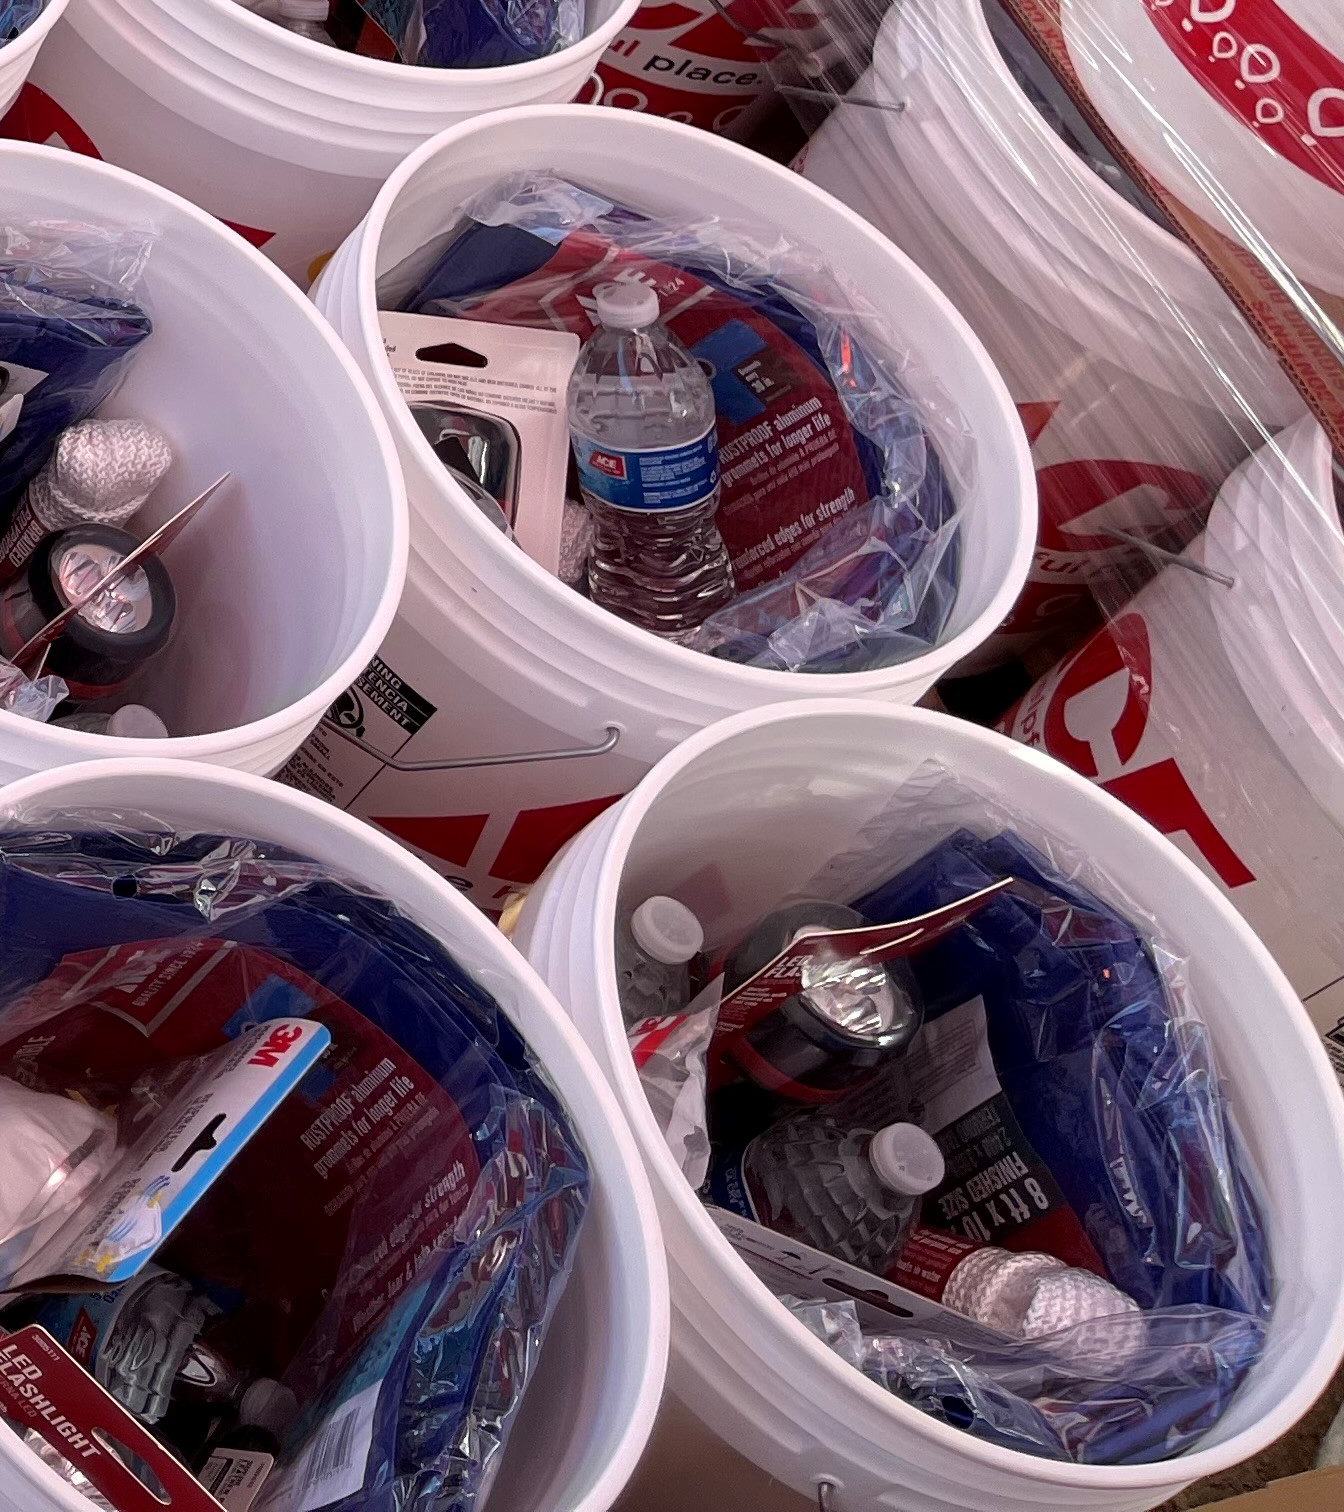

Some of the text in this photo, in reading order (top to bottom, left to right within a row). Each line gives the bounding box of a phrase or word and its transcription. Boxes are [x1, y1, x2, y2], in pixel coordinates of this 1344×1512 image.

[717, 396, 823, 465] RUSTPROOF aluminum
[720, 412, 832, 488] grommets for longer life
[595, 454, 618, 470] ACE
[774, 486, 856, 545] edges for strength
[8, 519, 45, 568] BRAIDED
[247, 1023, 303, 1068] 3M
[299, 1056, 397, 1151] RUSTPROOF aluminum
[314, 1073, 415, 1179] grommets longer life
[939, 1150, 1030, 1221] FINISHED SIZE
[1006, 1177, 1049, 1225] 8 ft
[0, 1343, 43, 1381] LED
[16, 1393, 39, 1420] LED
